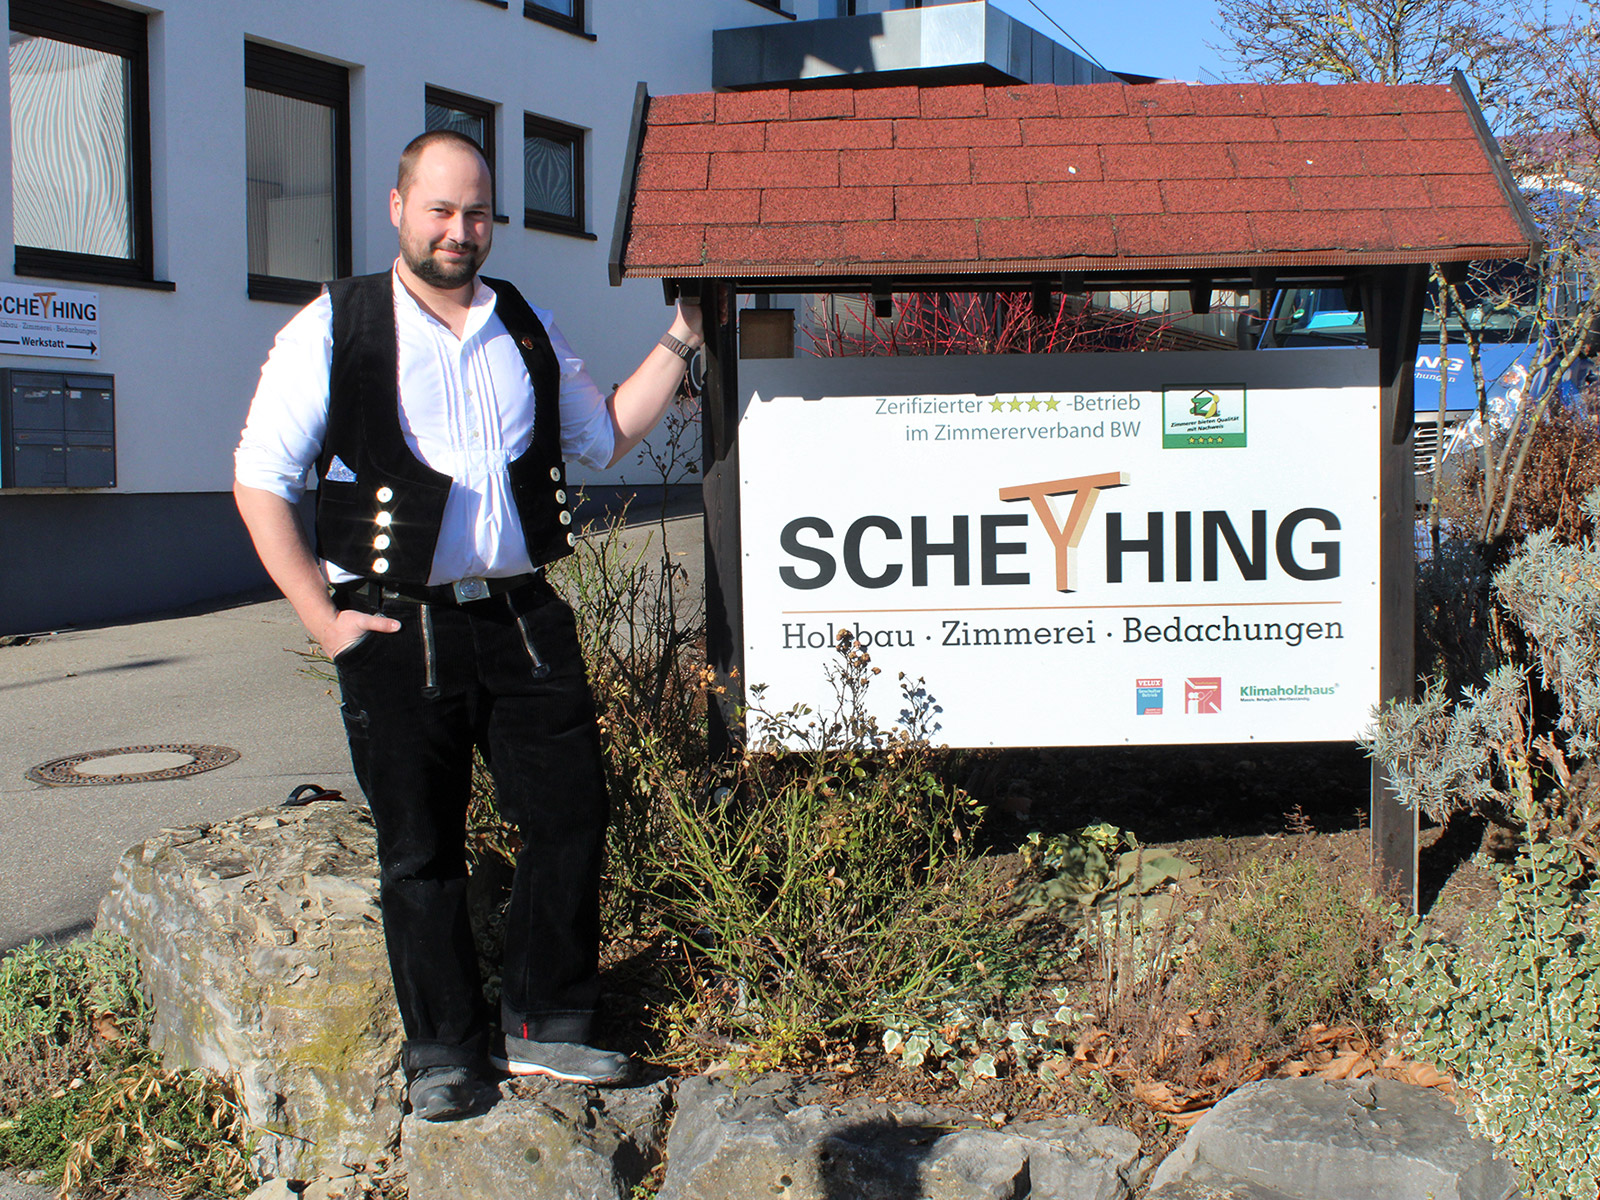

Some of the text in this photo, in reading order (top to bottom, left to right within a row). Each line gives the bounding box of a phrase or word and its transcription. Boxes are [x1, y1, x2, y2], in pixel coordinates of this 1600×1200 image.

[0, 292, 97, 321] CHEYHING
[21, 336, 65, 348] Werkstatt
[875, 397, 983, 415] Zerifizierter
[905, 421, 1141, 441] im Zimmererverband BW
[779, 471, 1342, 593] SCHEYHING
[782, 616, 1344, 649] Holbau Zimmerei Bedachungen
